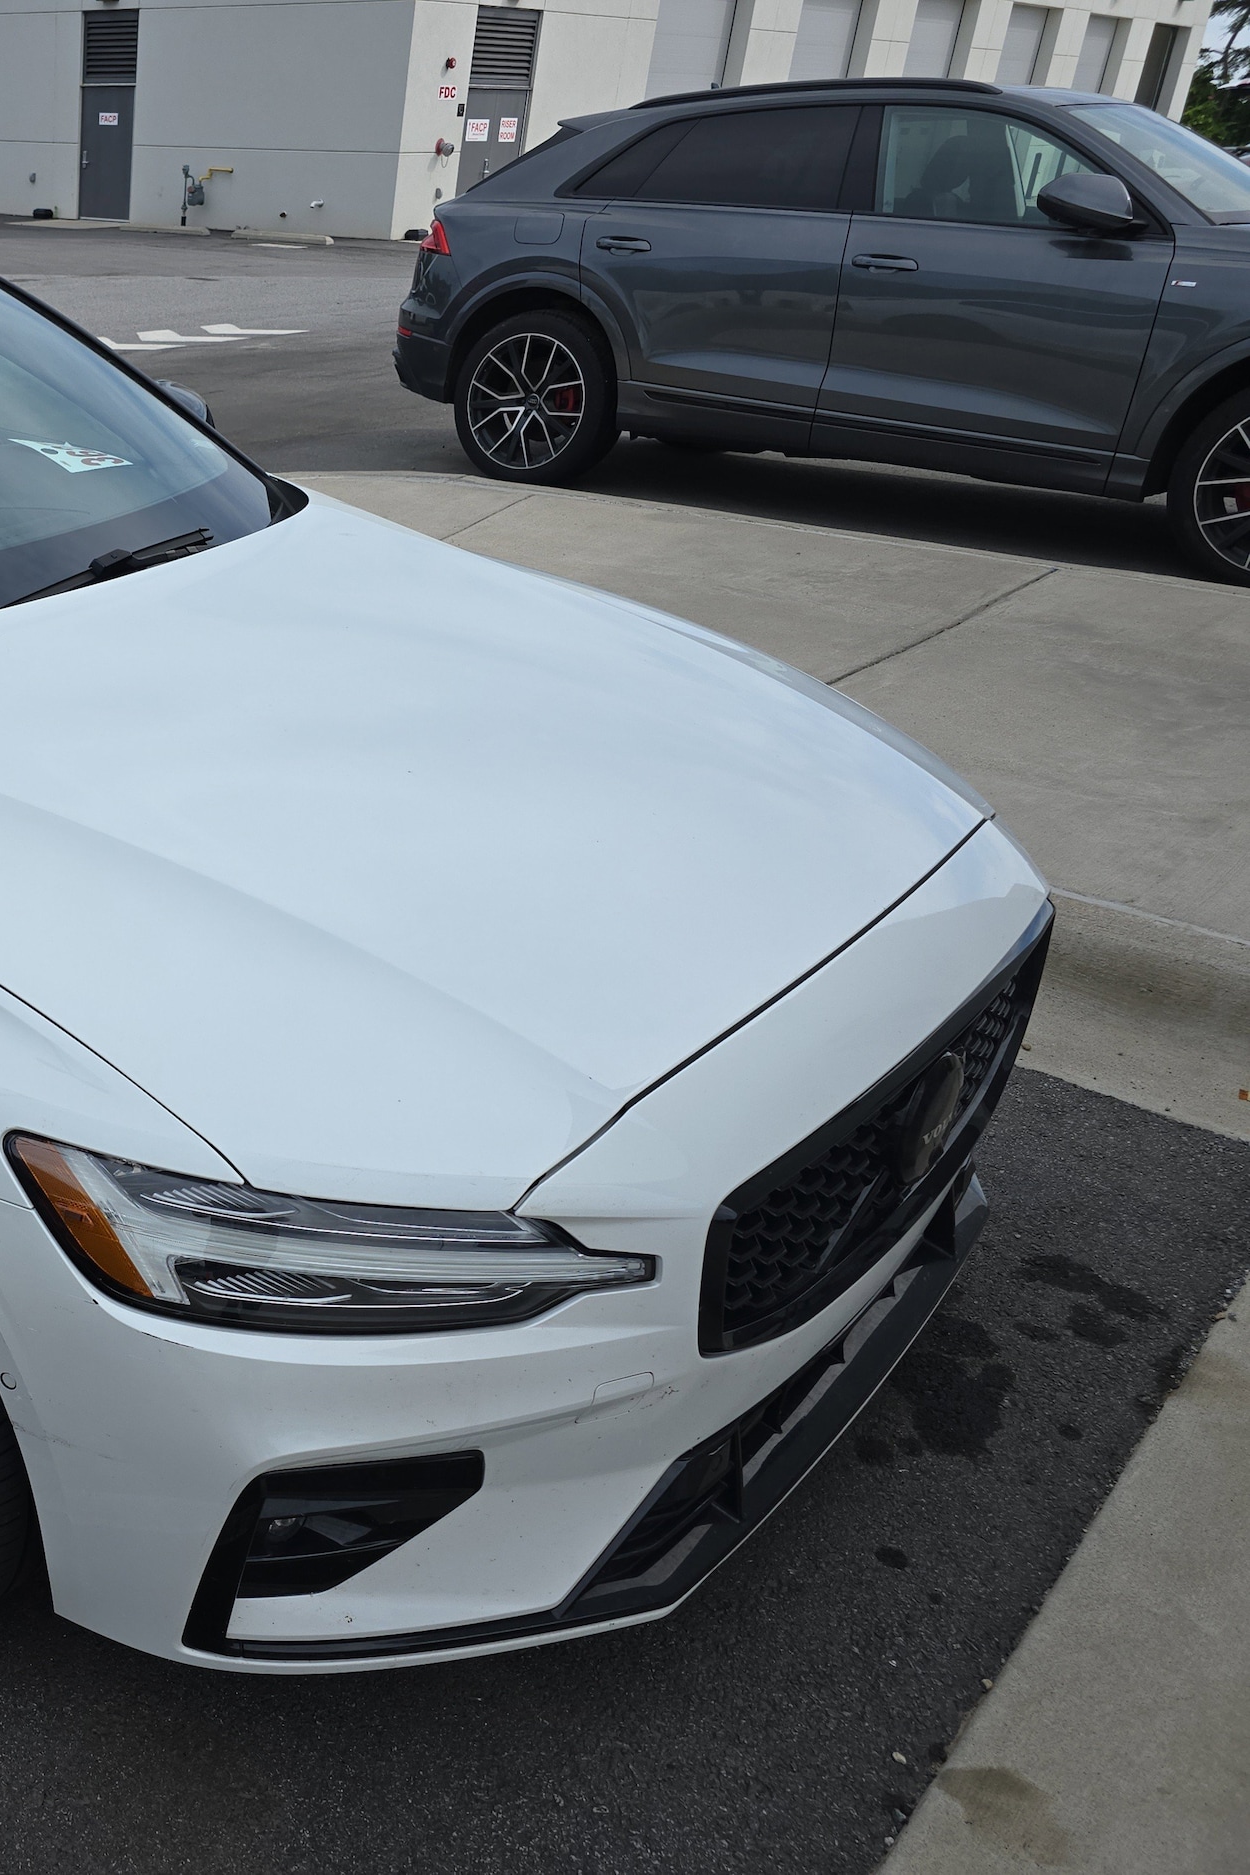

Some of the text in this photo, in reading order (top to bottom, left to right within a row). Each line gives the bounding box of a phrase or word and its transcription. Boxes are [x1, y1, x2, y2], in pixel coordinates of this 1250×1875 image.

[439, 86, 456, 98] FDC
[101, 115, 117, 123] FACP
[470, 122, 488, 133] FACP
[502, 120, 516, 128] RISER
[500, 132, 515, 140] ROOM
